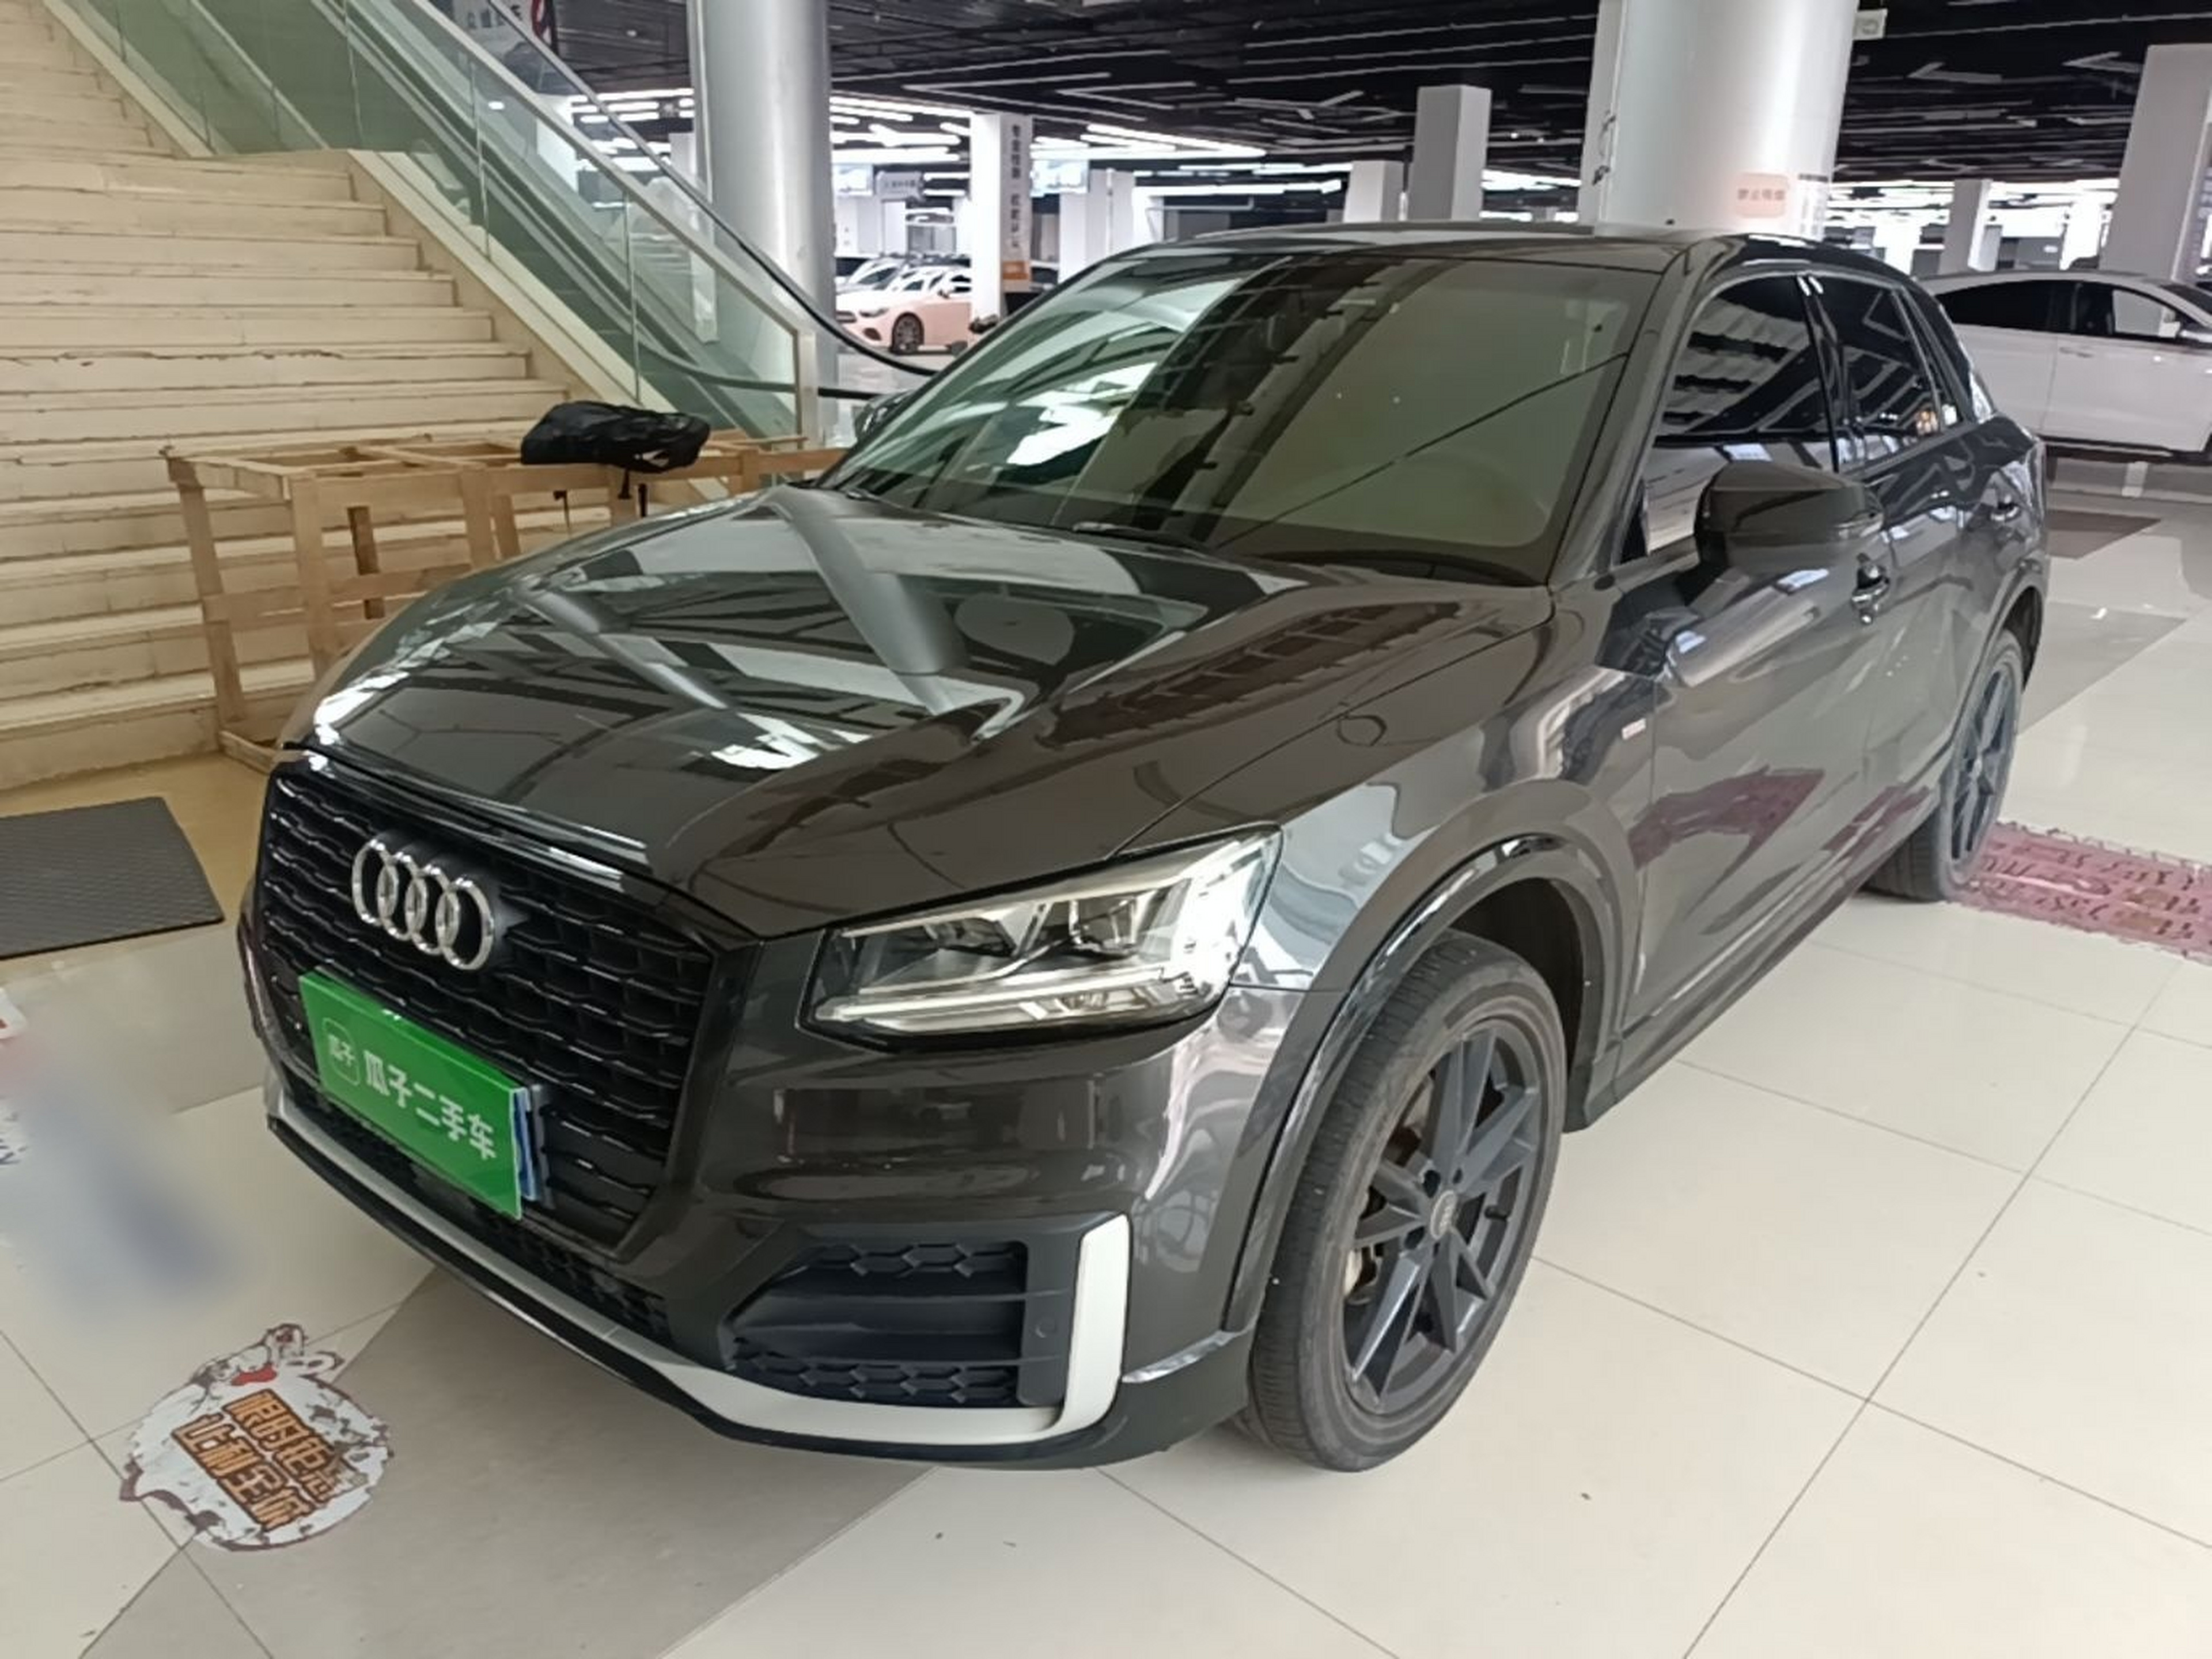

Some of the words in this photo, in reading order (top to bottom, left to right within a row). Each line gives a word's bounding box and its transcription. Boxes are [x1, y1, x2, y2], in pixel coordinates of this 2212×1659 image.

[363, 1050, 497, 1161] 瓜子二手车
